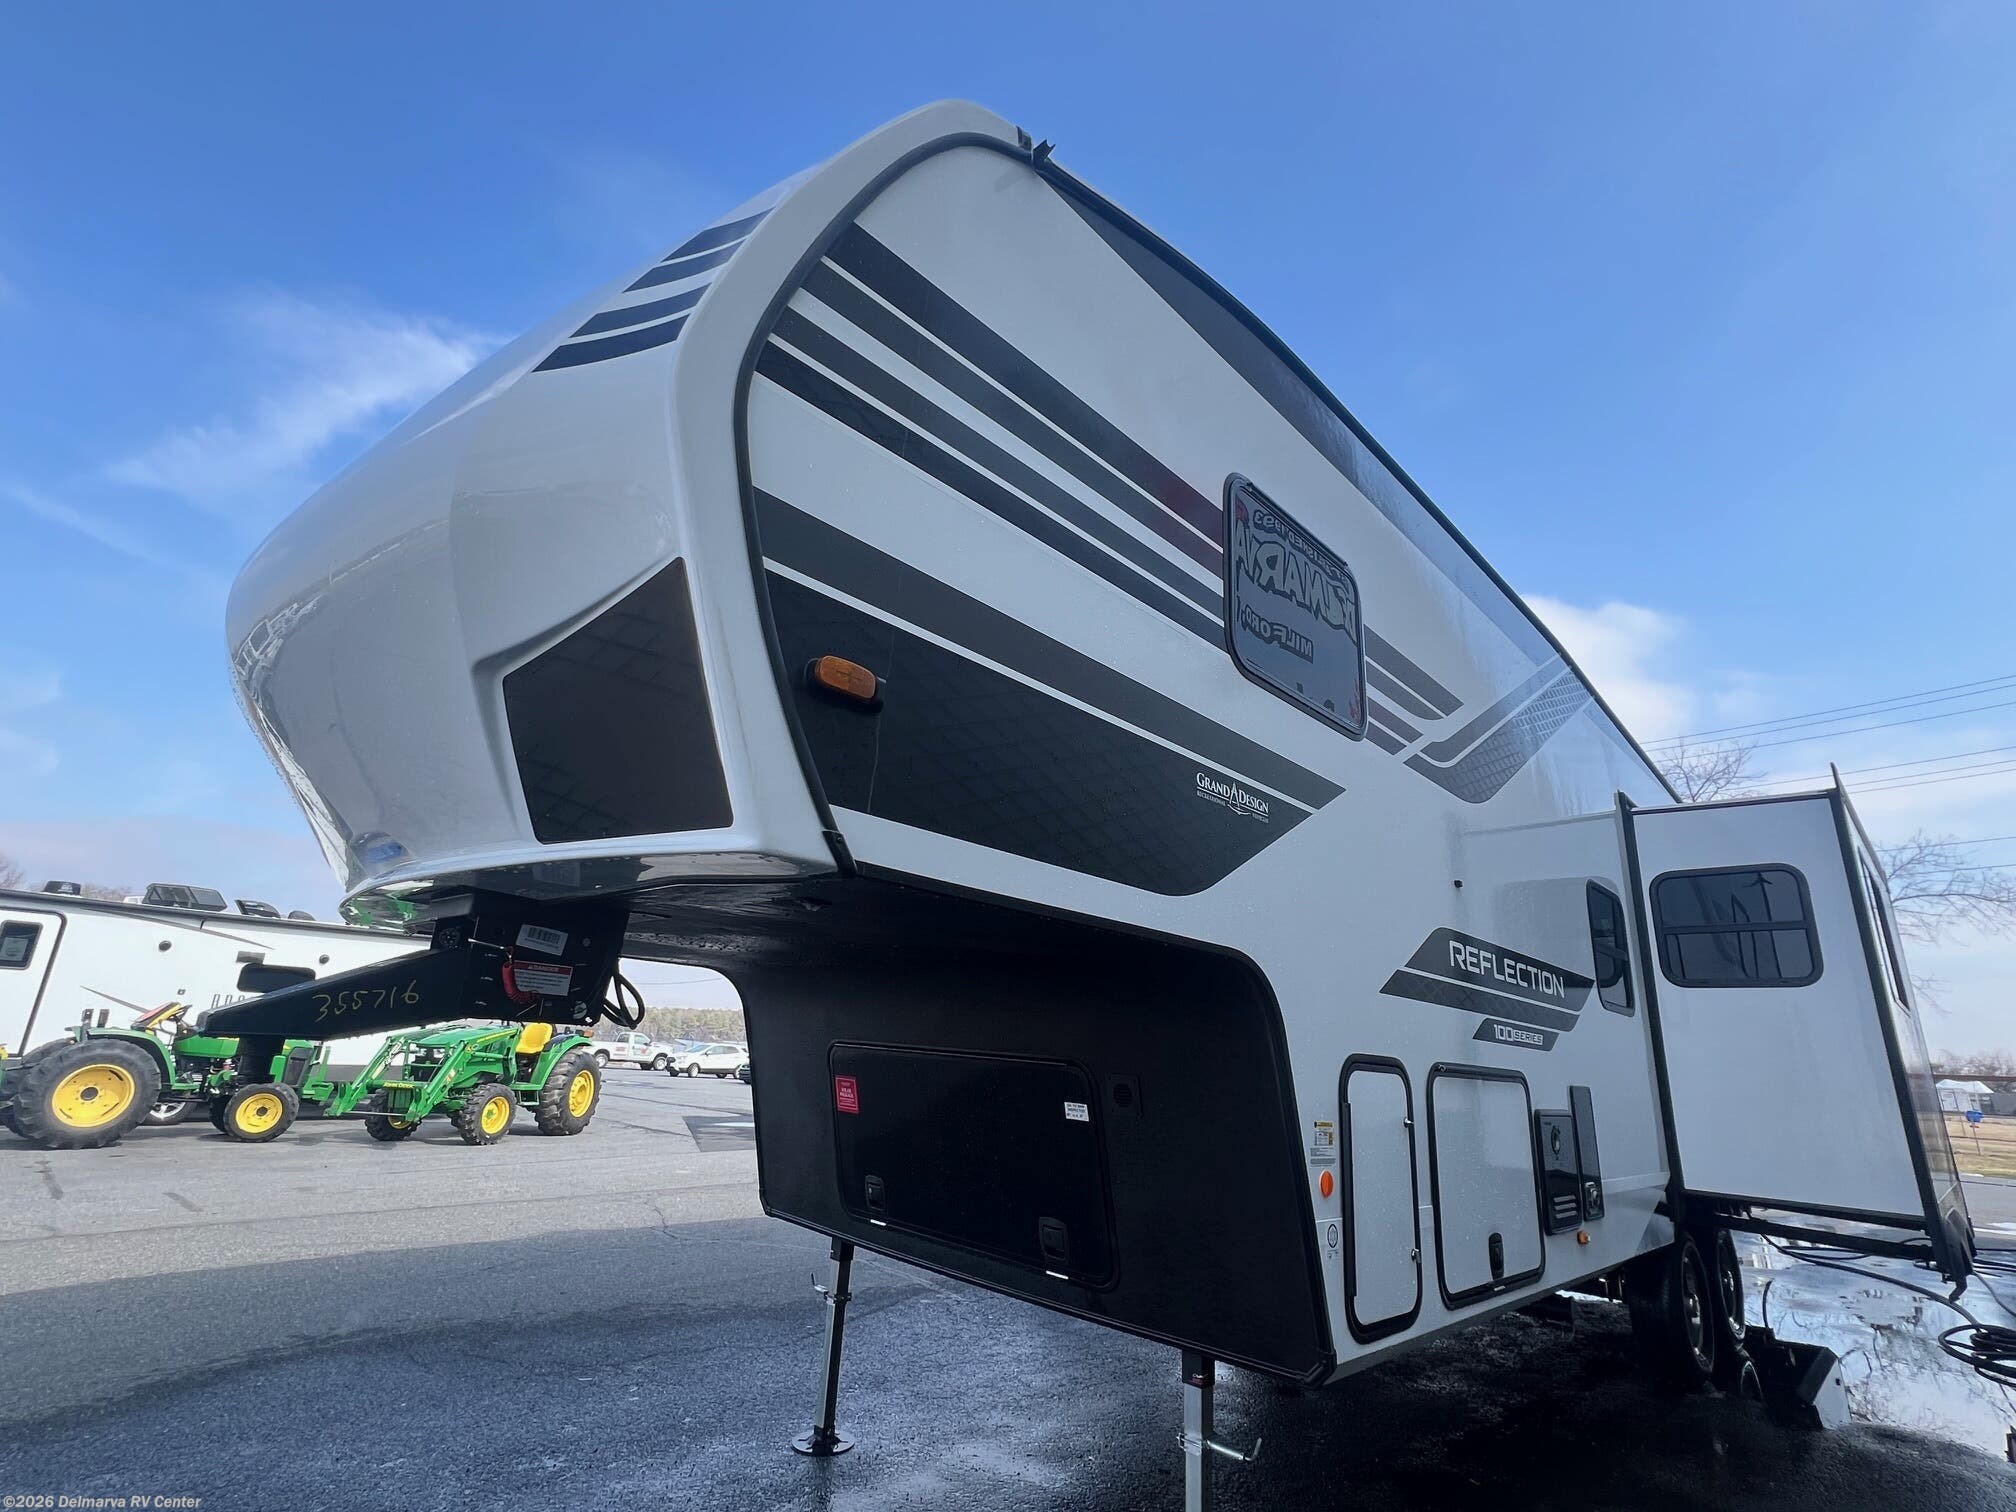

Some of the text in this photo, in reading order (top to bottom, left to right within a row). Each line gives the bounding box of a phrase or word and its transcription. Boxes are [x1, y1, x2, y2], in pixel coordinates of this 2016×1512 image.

[1196, 772, 1231, 798] GRAND
[1239, 789, 1269, 814] DESIGN
[1449, 940, 1565, 999] REFLECTION
[312, 979, 420, 1023] 355716
[1493, 1024, 1543, 1045] 100 SERIES
